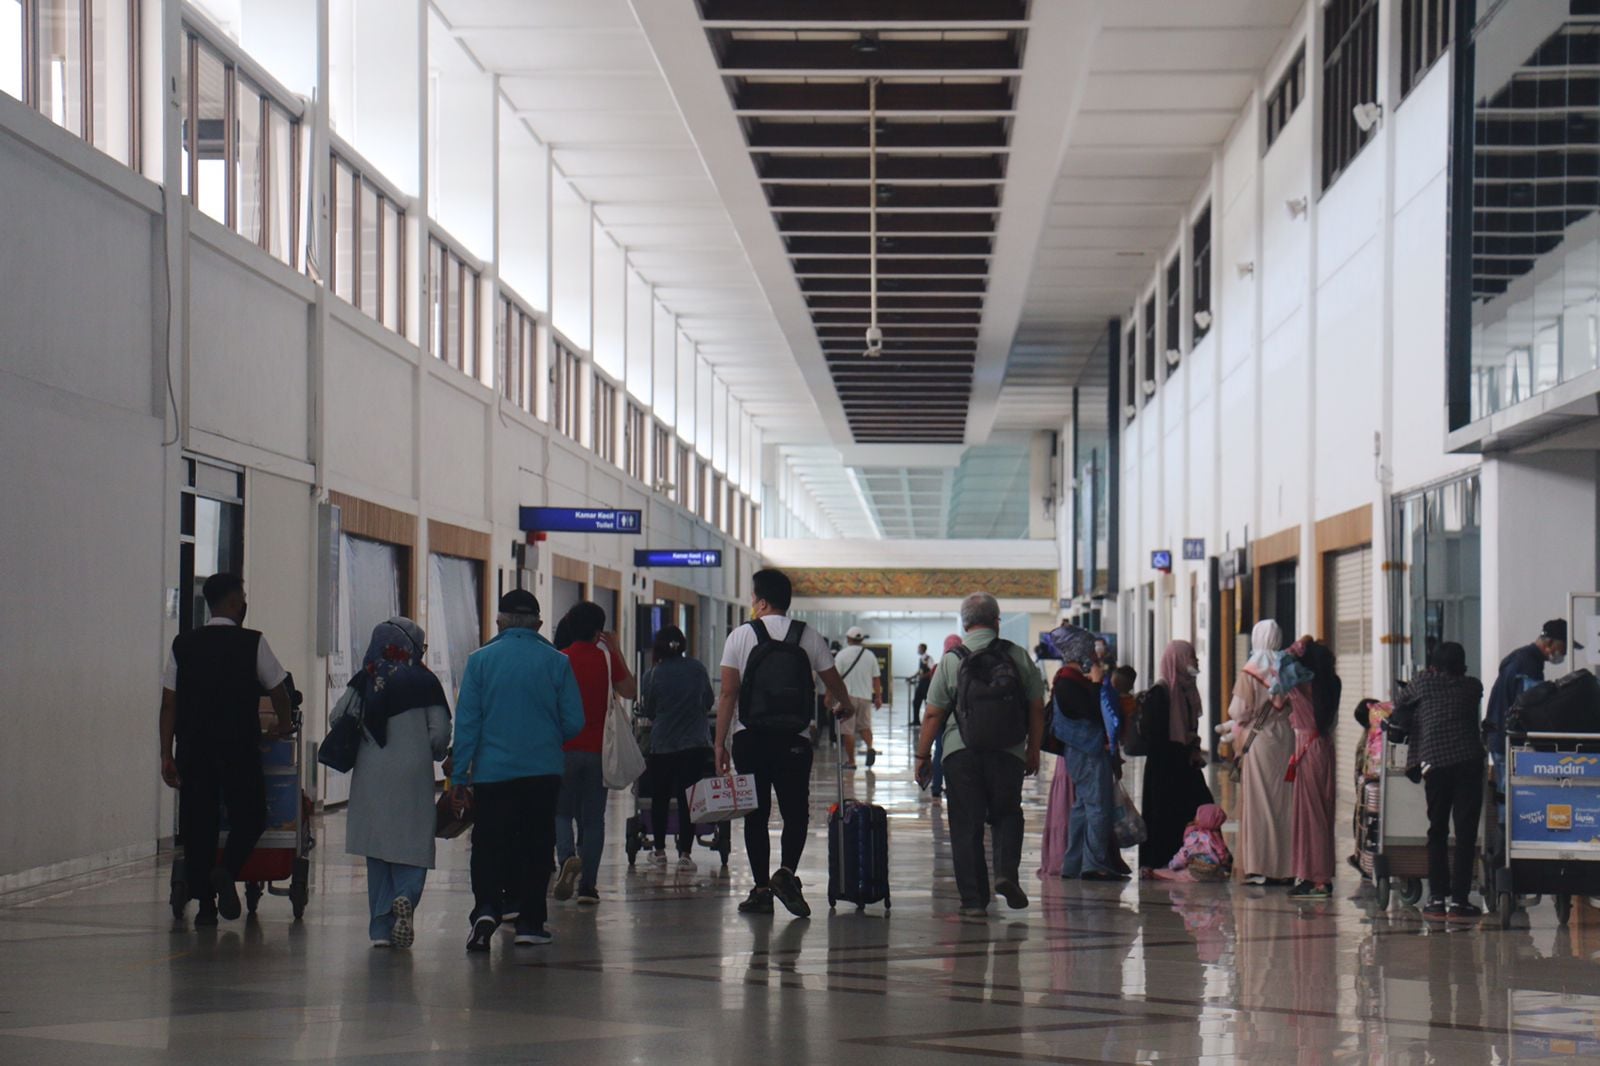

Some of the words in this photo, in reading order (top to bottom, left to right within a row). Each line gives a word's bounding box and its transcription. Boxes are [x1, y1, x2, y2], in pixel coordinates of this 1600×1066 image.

[575, 511, 597, 519] Kamar
[598, 512, 614, 520] Kecil
[1534, 763, 1584, 774] mandiri
